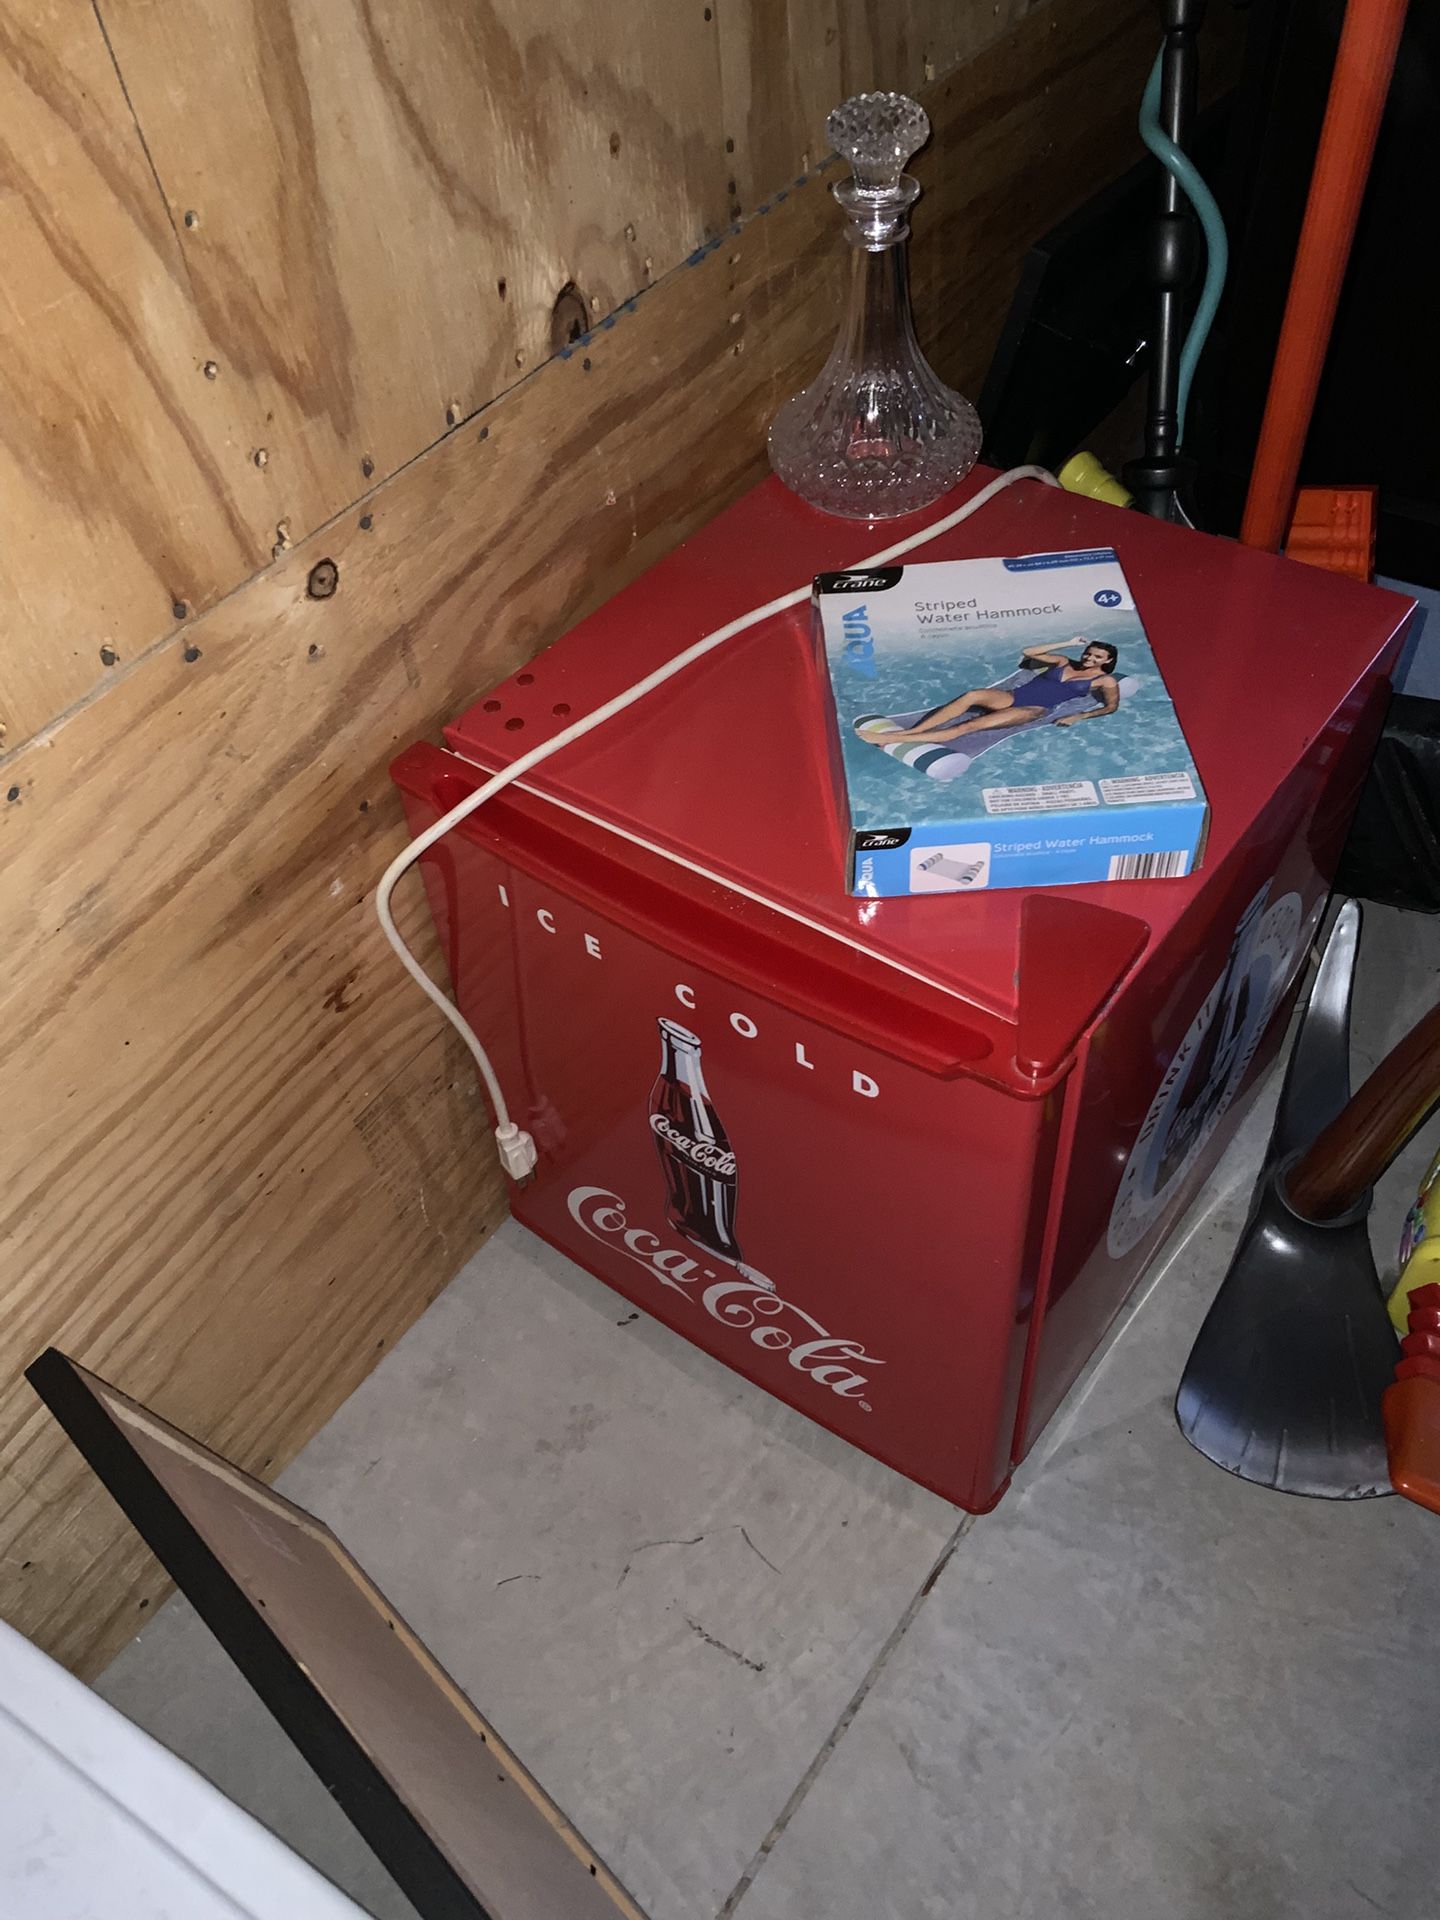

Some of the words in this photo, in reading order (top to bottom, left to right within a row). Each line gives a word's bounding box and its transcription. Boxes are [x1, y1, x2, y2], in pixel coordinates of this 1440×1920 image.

[914, 598, 978, 613] Striped
[916, 612, 971, 625] Water
[976, 603, 1063, 621] Hammock
[1096, 591, 1121, 605] 4+
[993, 839, 1042, 853] Striped
[1045, 836, 1086, 849] Water
[1089, 832, 1154, 845] Hammock
[498, 885, 602, 959] ICE
[675, 984, 880, 1098] COLD
[649, 1113, 737, 1176] Coca-Cola
[567, 1186, 886, 1398] Coca-Cola
